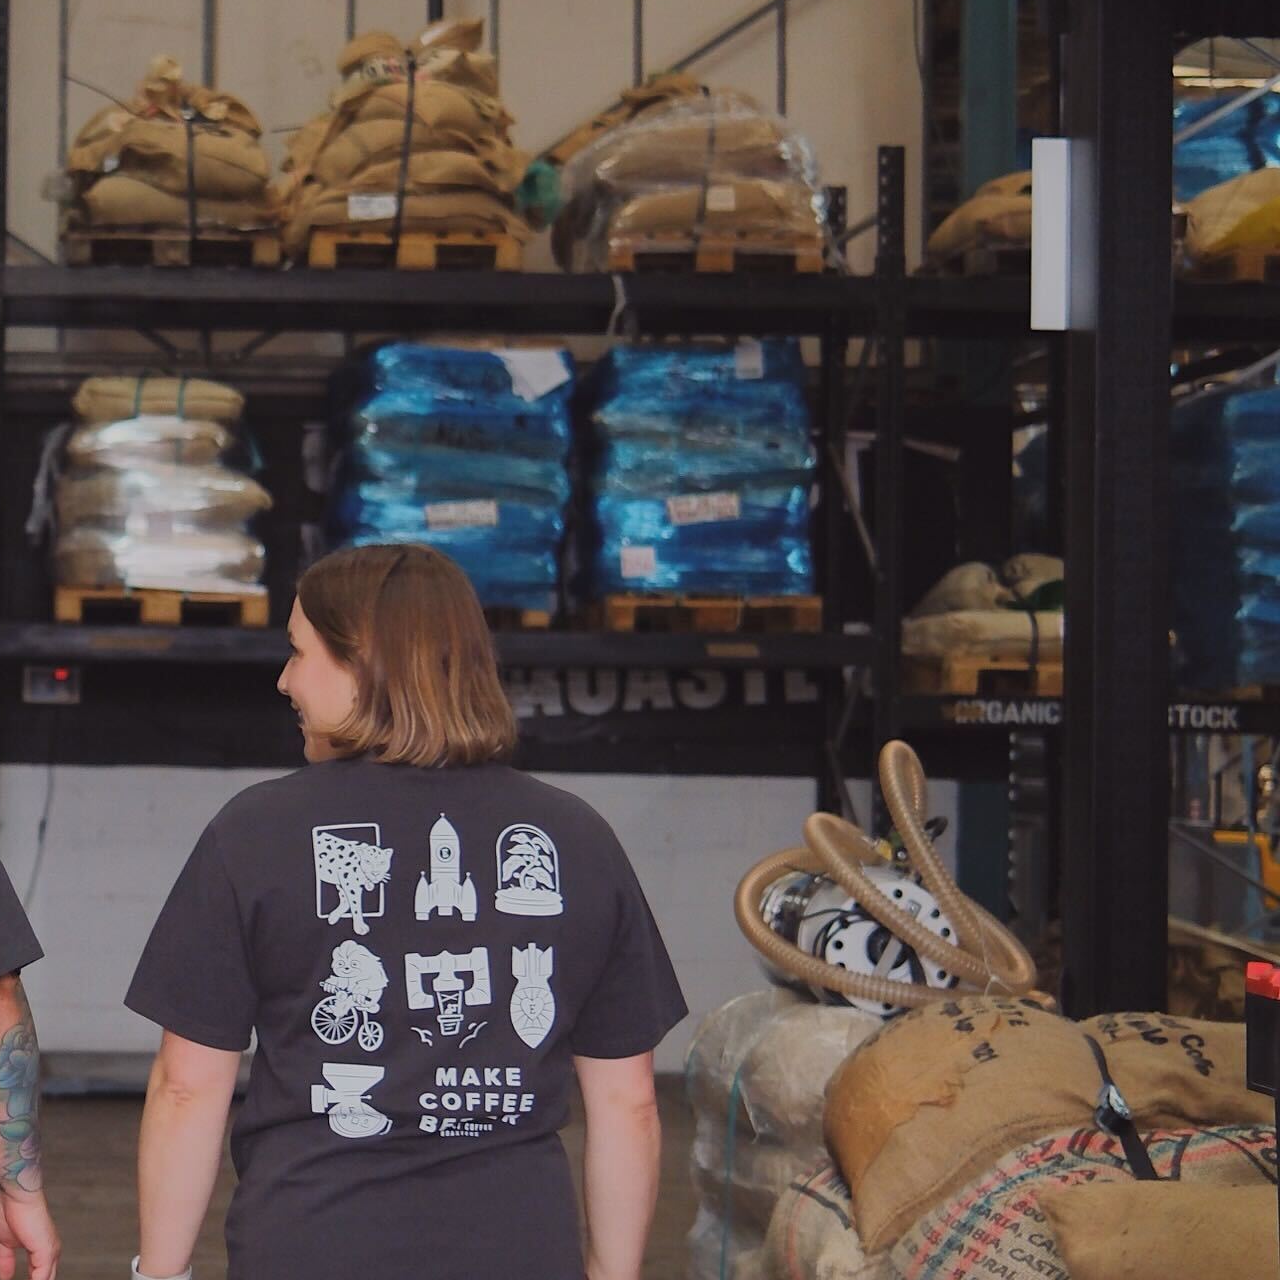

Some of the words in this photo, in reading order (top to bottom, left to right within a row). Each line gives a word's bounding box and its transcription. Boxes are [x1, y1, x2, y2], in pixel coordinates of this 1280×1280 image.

[954, 700, 1061, 725] ORGANIC
[1168, 704, 1239, 729] TOCK
[435, 1067, 521, 1087] MAKE
[418, 1092, 535, 1112] COFFEE
